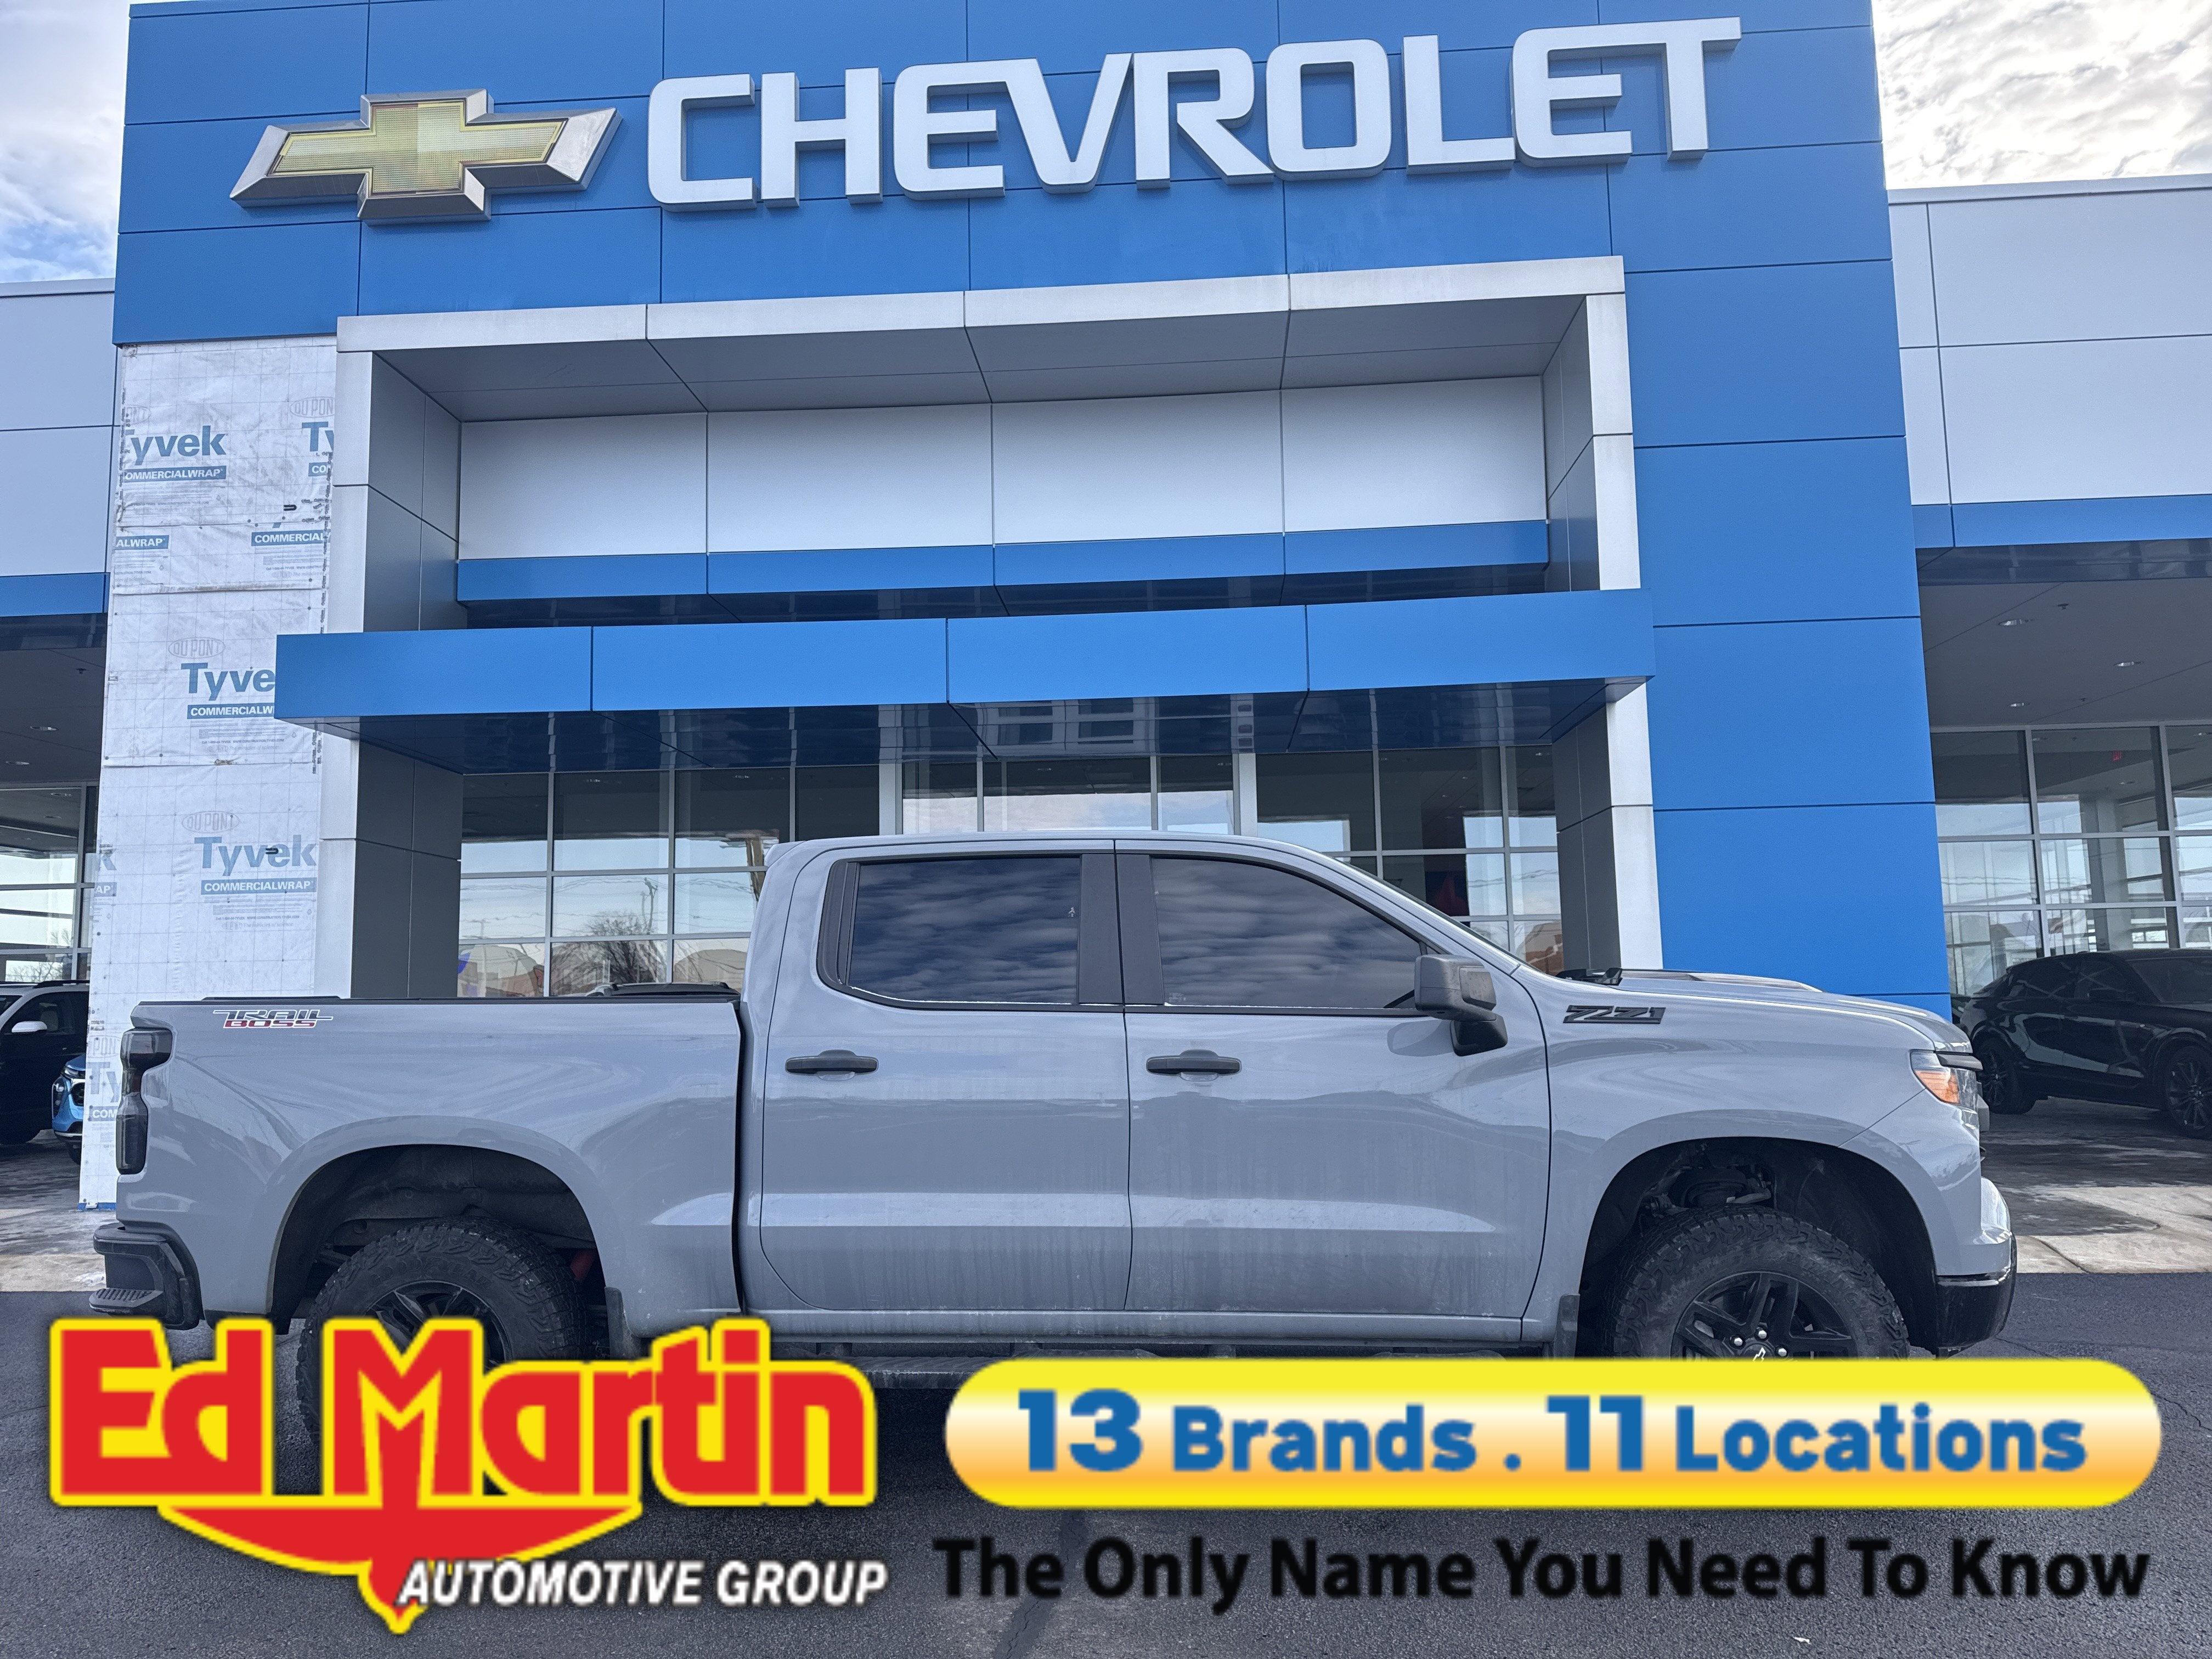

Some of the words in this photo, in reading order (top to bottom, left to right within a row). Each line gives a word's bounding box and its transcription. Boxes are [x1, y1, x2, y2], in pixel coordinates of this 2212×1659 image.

[648, 16, 1741, 212] CHEVROLET
[125, 469, 221, 481] OMMERCIALWRAP
[194, 834, 317, 876] Tyvek
[204, 881, 311, 891] COMMERCIALWRAP
[213, 1009, 334, 1020] TRAIL
[1563, 1005, 1666, 1024] Z71
[223, 1019, 317, 1029] BOSS
